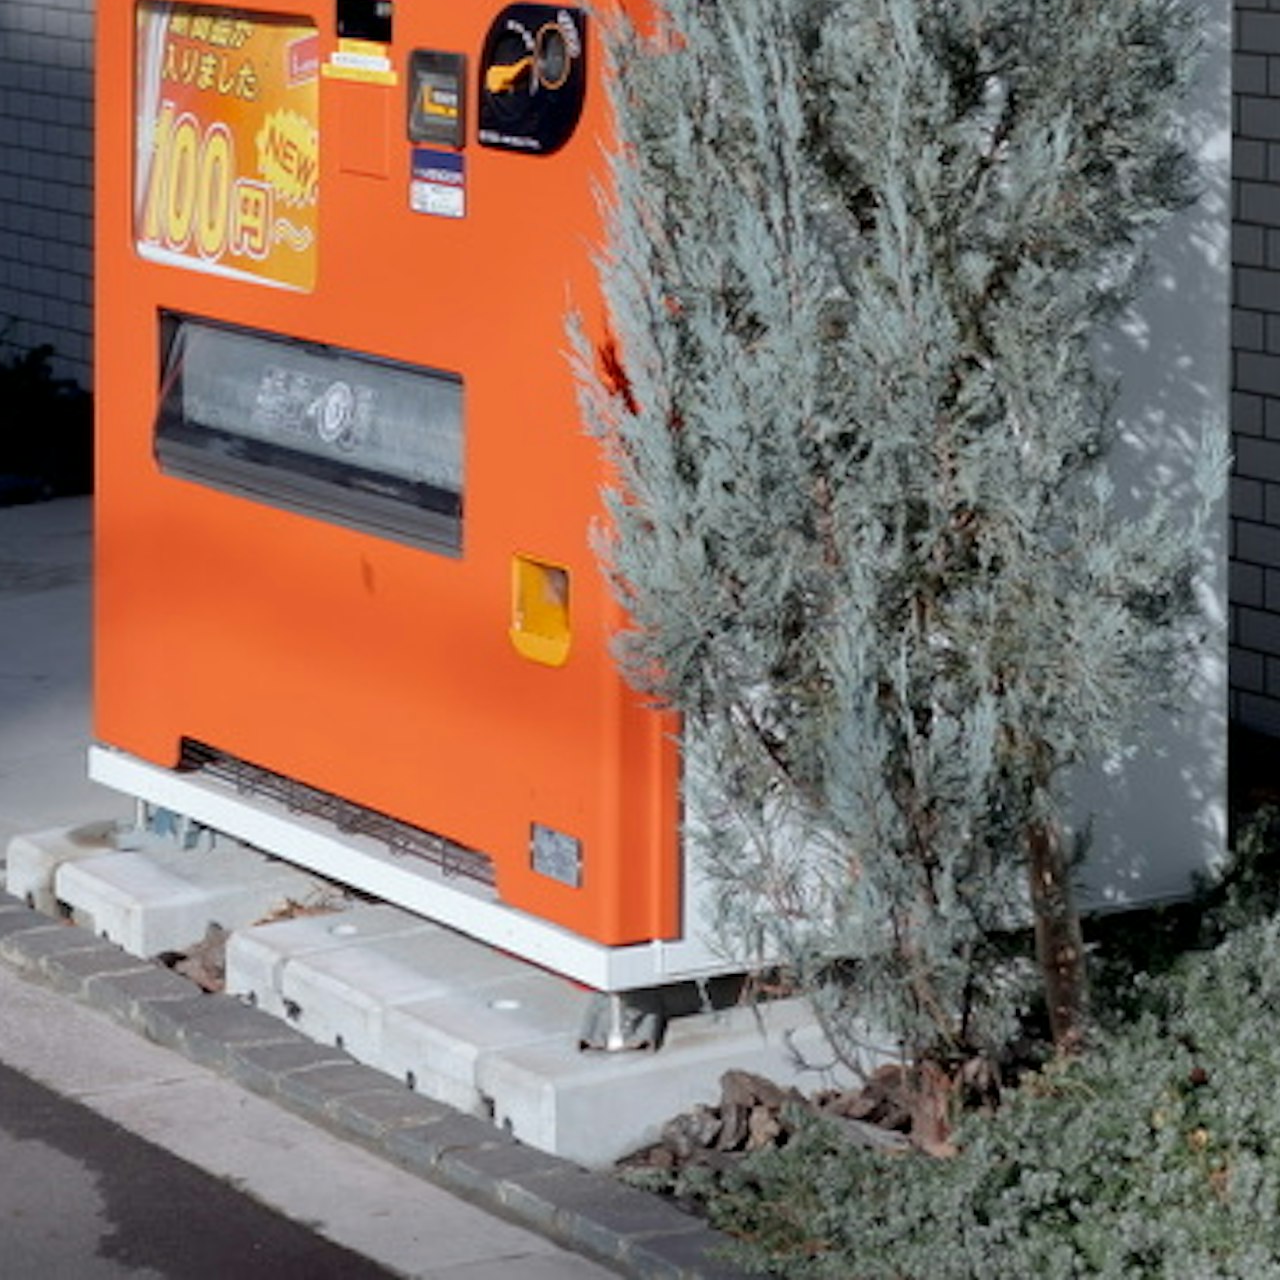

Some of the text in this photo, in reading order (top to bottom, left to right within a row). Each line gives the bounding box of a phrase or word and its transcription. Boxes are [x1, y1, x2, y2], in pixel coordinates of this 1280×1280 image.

[162, 43, 258, 99] 入りました
[265, 126, 315, 186] NEW
